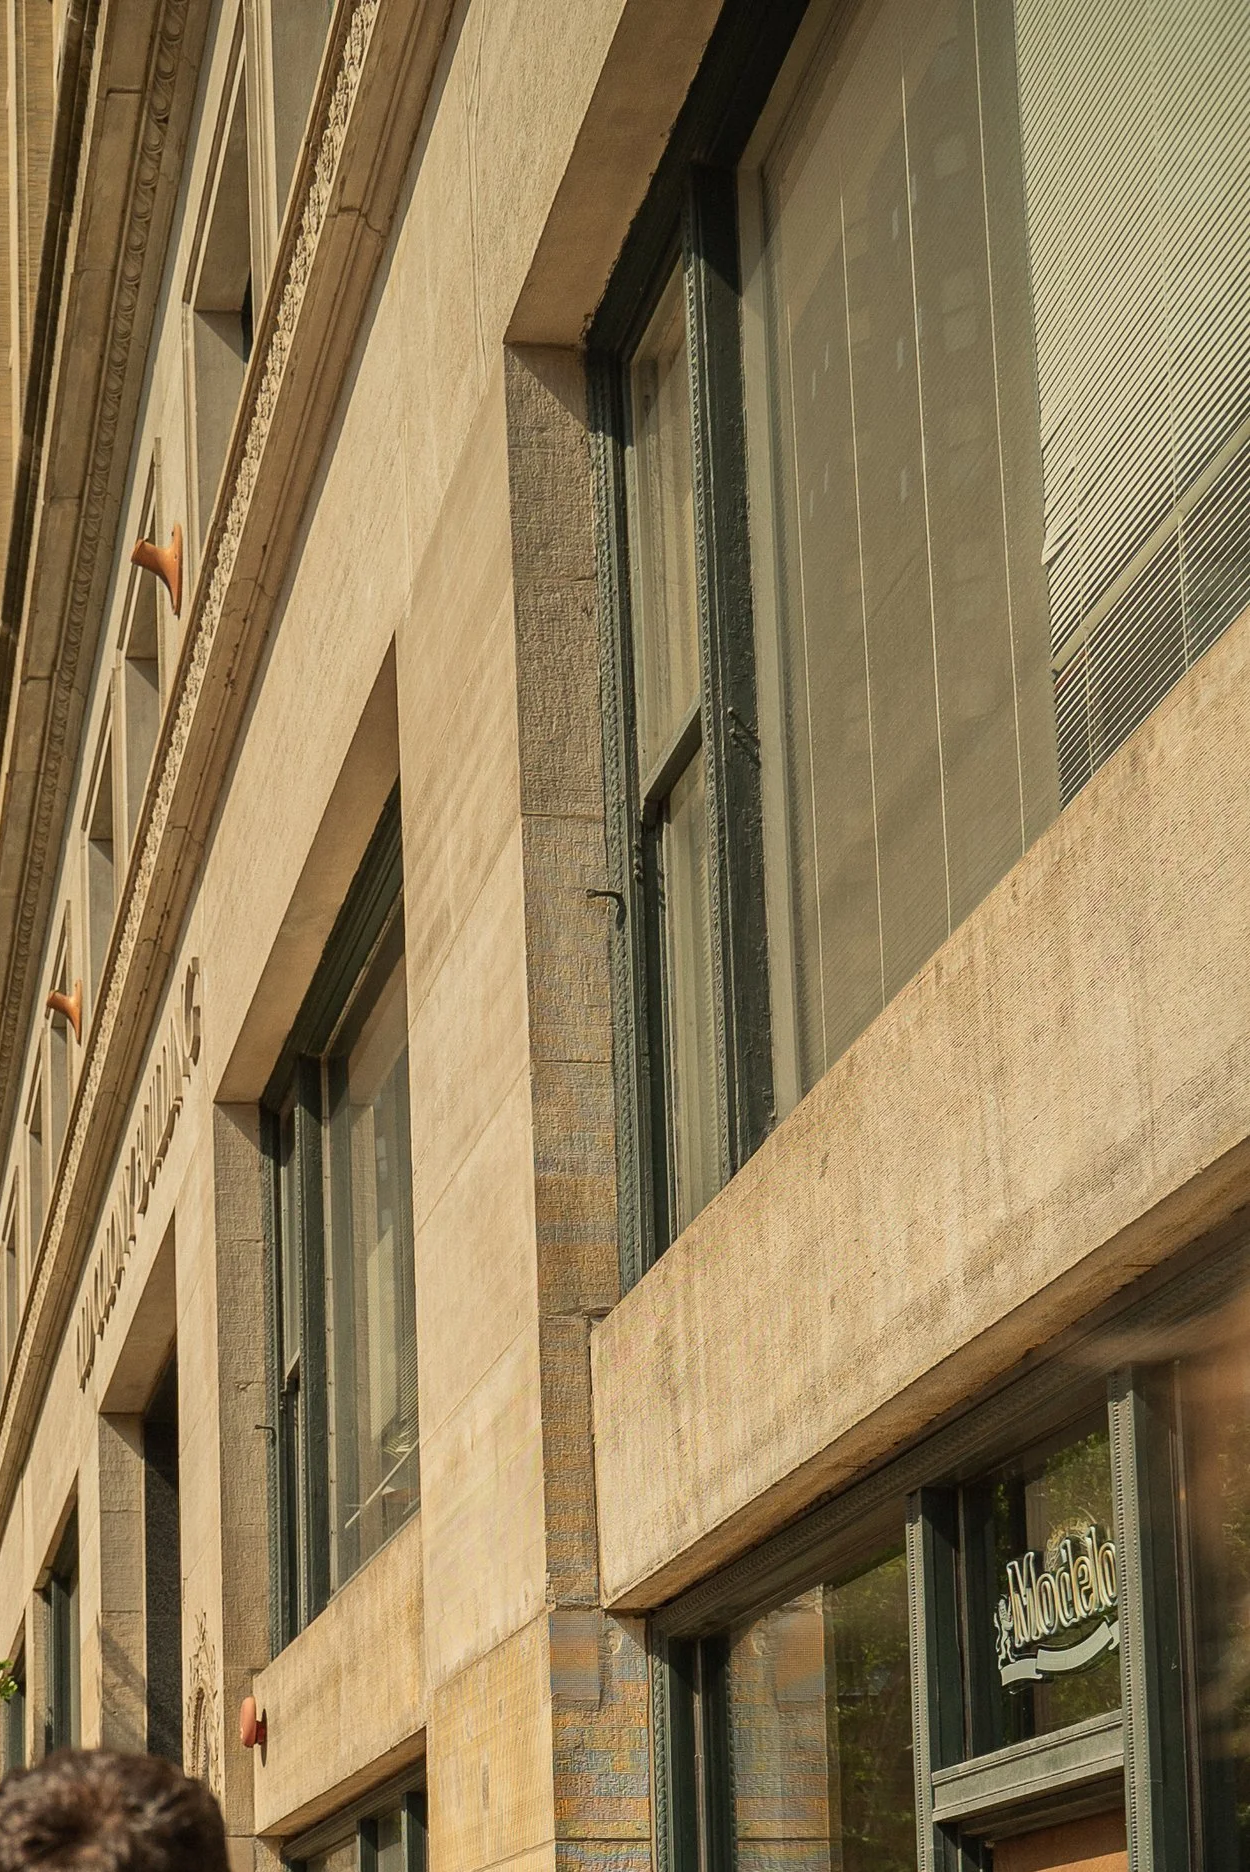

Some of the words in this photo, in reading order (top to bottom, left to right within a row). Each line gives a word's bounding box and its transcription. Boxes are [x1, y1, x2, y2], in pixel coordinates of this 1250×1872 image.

[92, 1145, 137, 1341] COLONY
[136, 956, 202, 1214] BUILDING
[1006, 1525, 1118, 1648] Modelo
